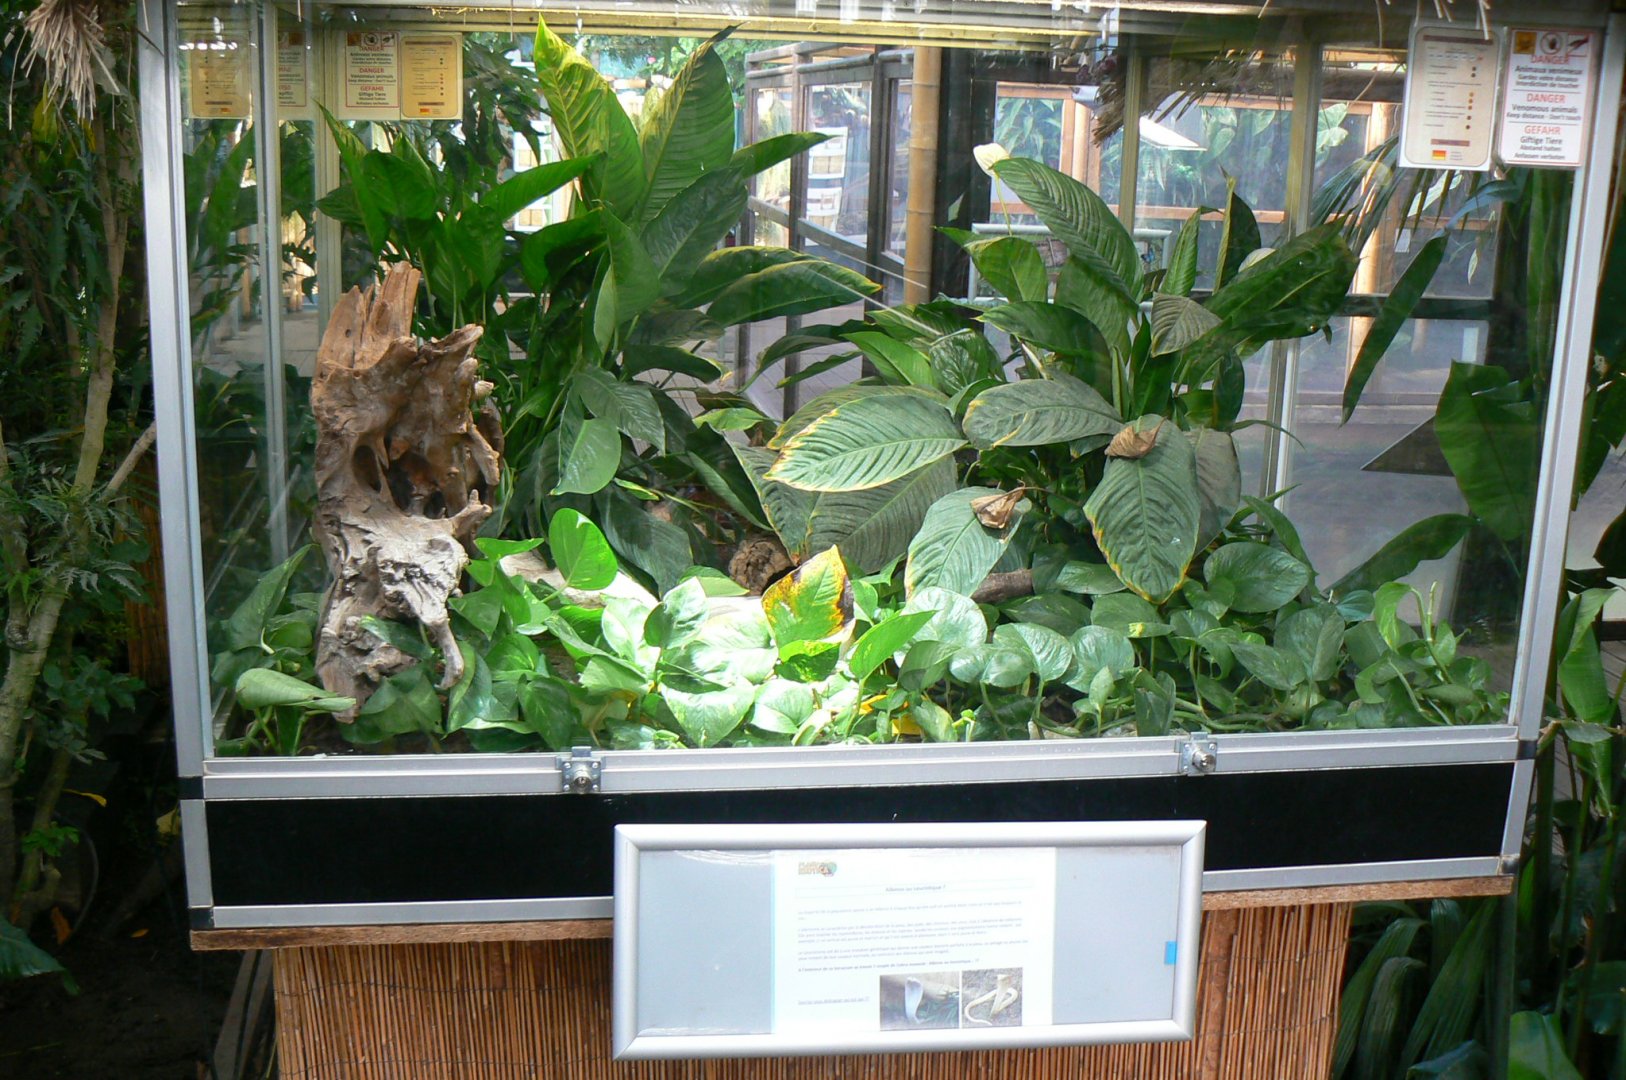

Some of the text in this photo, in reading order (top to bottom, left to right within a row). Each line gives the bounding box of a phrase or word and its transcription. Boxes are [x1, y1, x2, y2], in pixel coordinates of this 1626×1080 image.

[1530, 54, 1570, 64] DANGER
[1526, 93, 1565, 103] DANGER
[1512, 104, 1549, 112] Venomous
[1524, 125, 1561, 135] GEFAHR
[1520, 136, 1562, 145] Giftige Tiere
